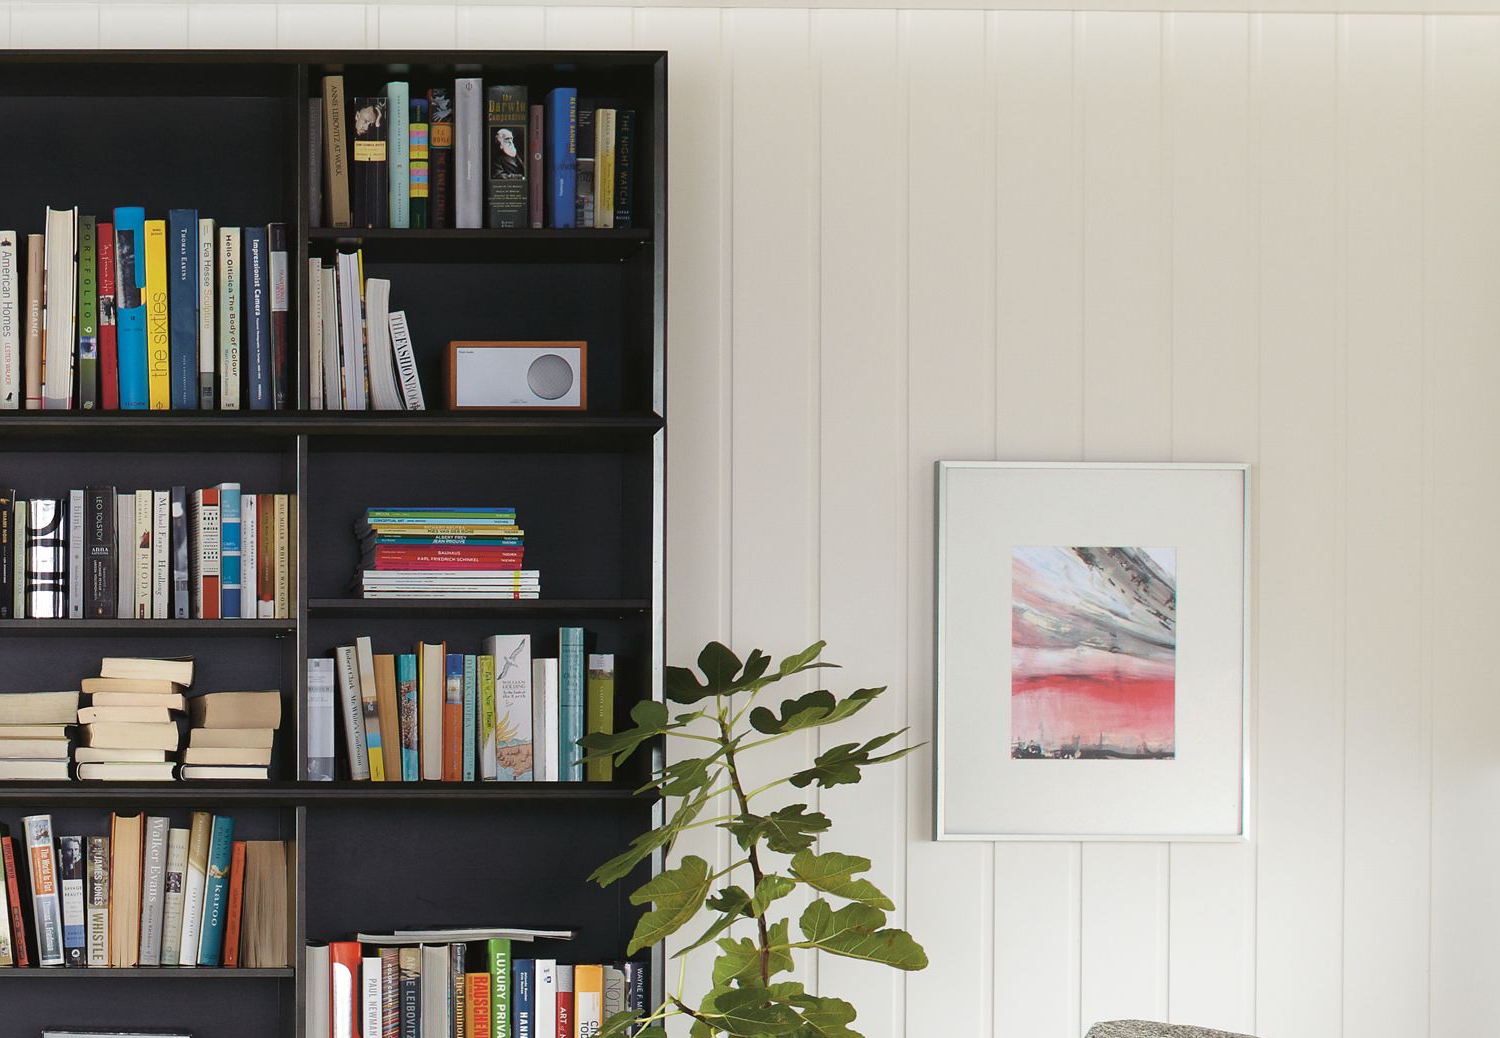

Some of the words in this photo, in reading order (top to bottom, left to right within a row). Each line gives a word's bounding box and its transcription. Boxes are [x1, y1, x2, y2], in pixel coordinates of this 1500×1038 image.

[621, 136, 629, 166] NIGHT
[203, 242, 211, 258] Eva
[251, 239, 260, 287] Impressionist
[1, 251, 12, 299] American
[203, 260, 211, 287] Hesse
[203, 289, 212, 329] Sculpture
[253, 289, 262, 316] Camera
[3, 301, 13, 337] Homes
[150, 292, 168, 345] sixties
[228, 313, 236, 334] Body
[230, 336, 237, 347] of
[153, 349, 168, 378] the
[158, 497, 167, 528] Michael
[156, 531, 167, 553] Frayn
[155, 560, 166, 596] Headlong
[41, 848, 50, 859] The
[151, 818, 163, 862] Walker
[41, 858, 51, 875] World
[93, 856, 102, 880] JAMES
[43, 881, 52, 892] Flat
[94, 882, 103, 906] JONES
[149, 866, 161, 902] Evans
[43, 901, 51, 920] Thomas
[211, 884, 223, 927] karoo
[45, 927, 54, 952] Friedman
[92, 913, 104, 961] WHISTLE
[406, 956, 416, 986] ANNIE
[456, 975, 465, 995] The
[496, 952, 506, 1000] LUXURY
[369, 978, 377, 998] PAUL
[369, 1001, 377, 1037] NEWMAN
[559, 1007, 567, 1024] ART
